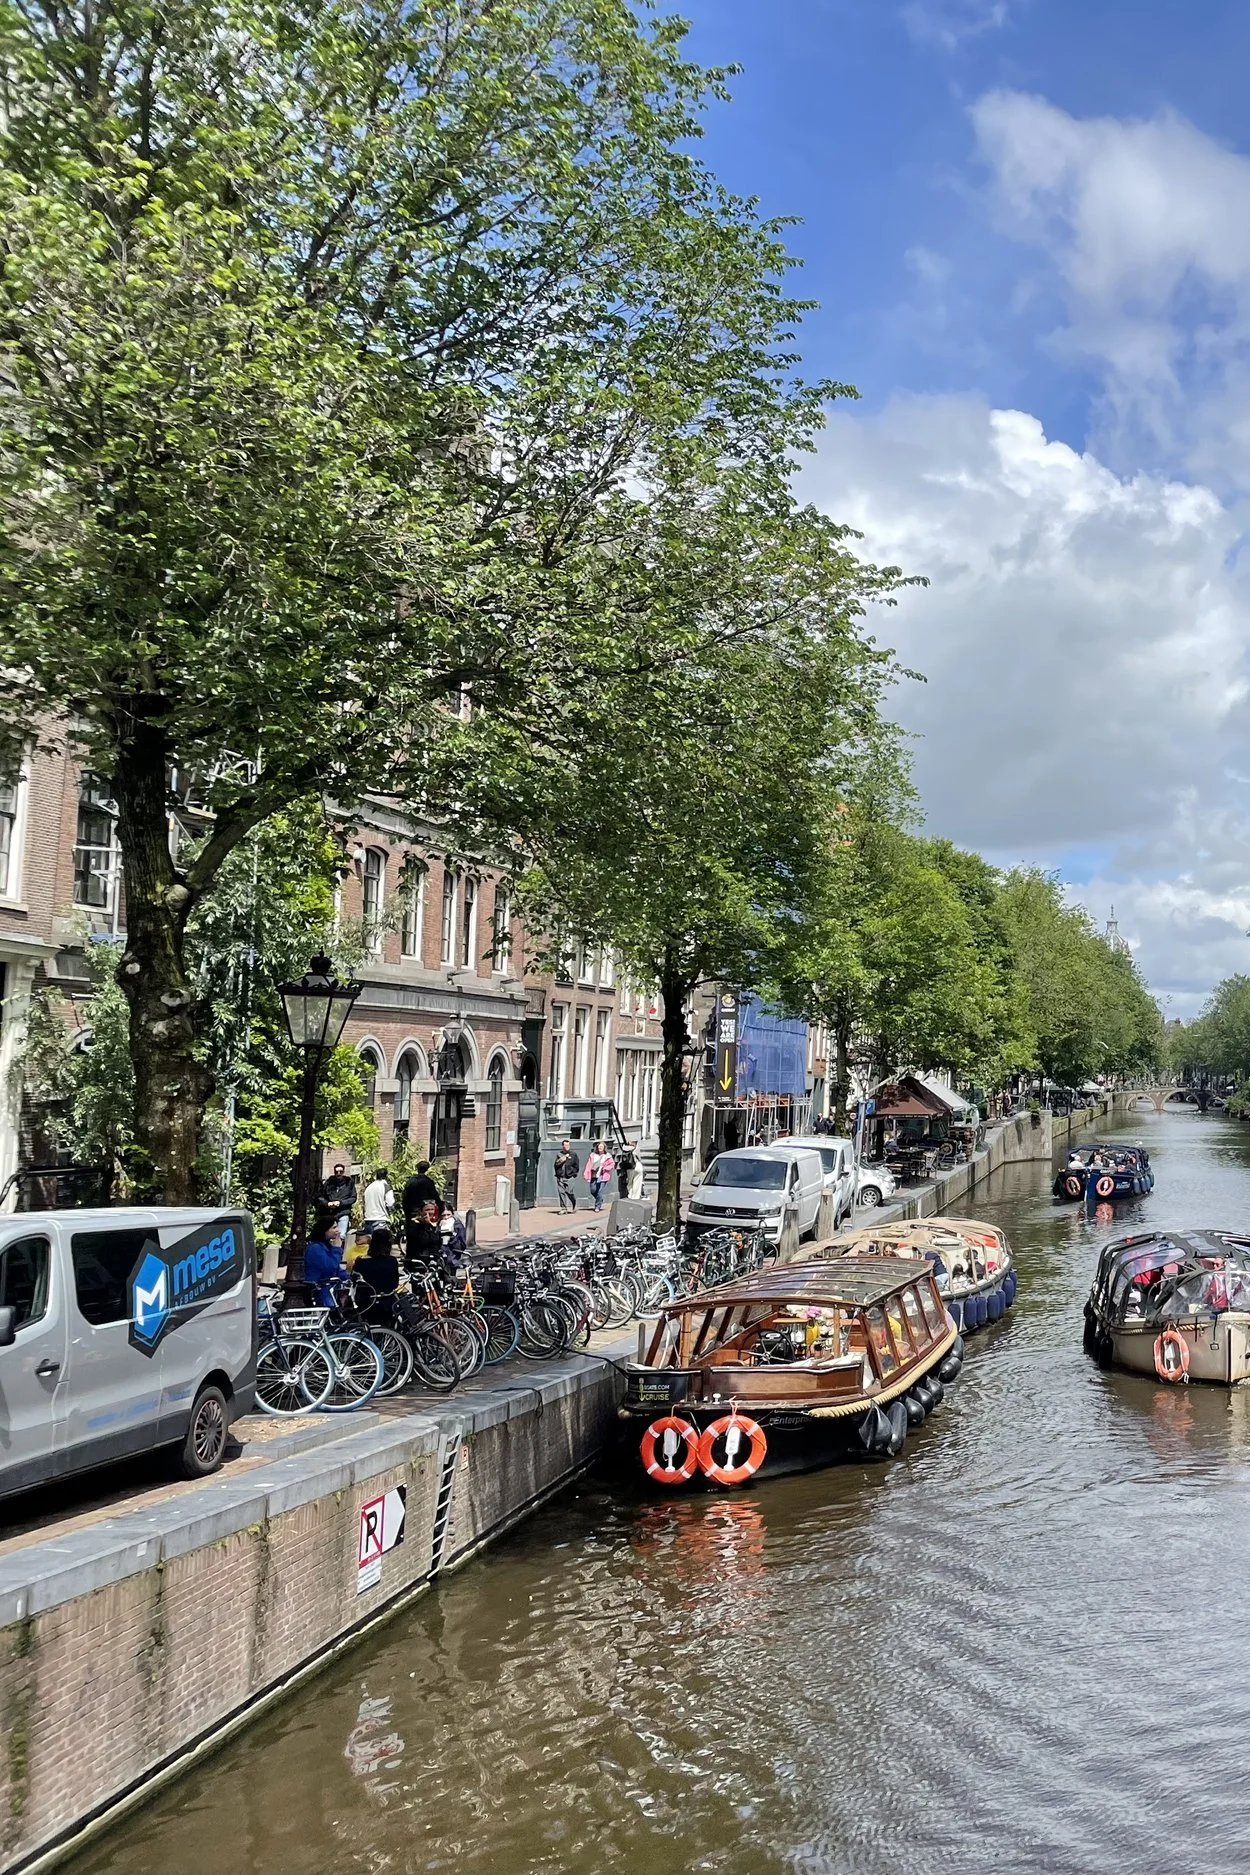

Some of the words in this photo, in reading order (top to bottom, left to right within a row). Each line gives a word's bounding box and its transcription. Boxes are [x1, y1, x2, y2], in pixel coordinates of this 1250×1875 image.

[720, 1025, 736, 1033] WE
[172, 1228, 236, 1296] mesa
[645, 1393, 670, 1401] CRUISE
